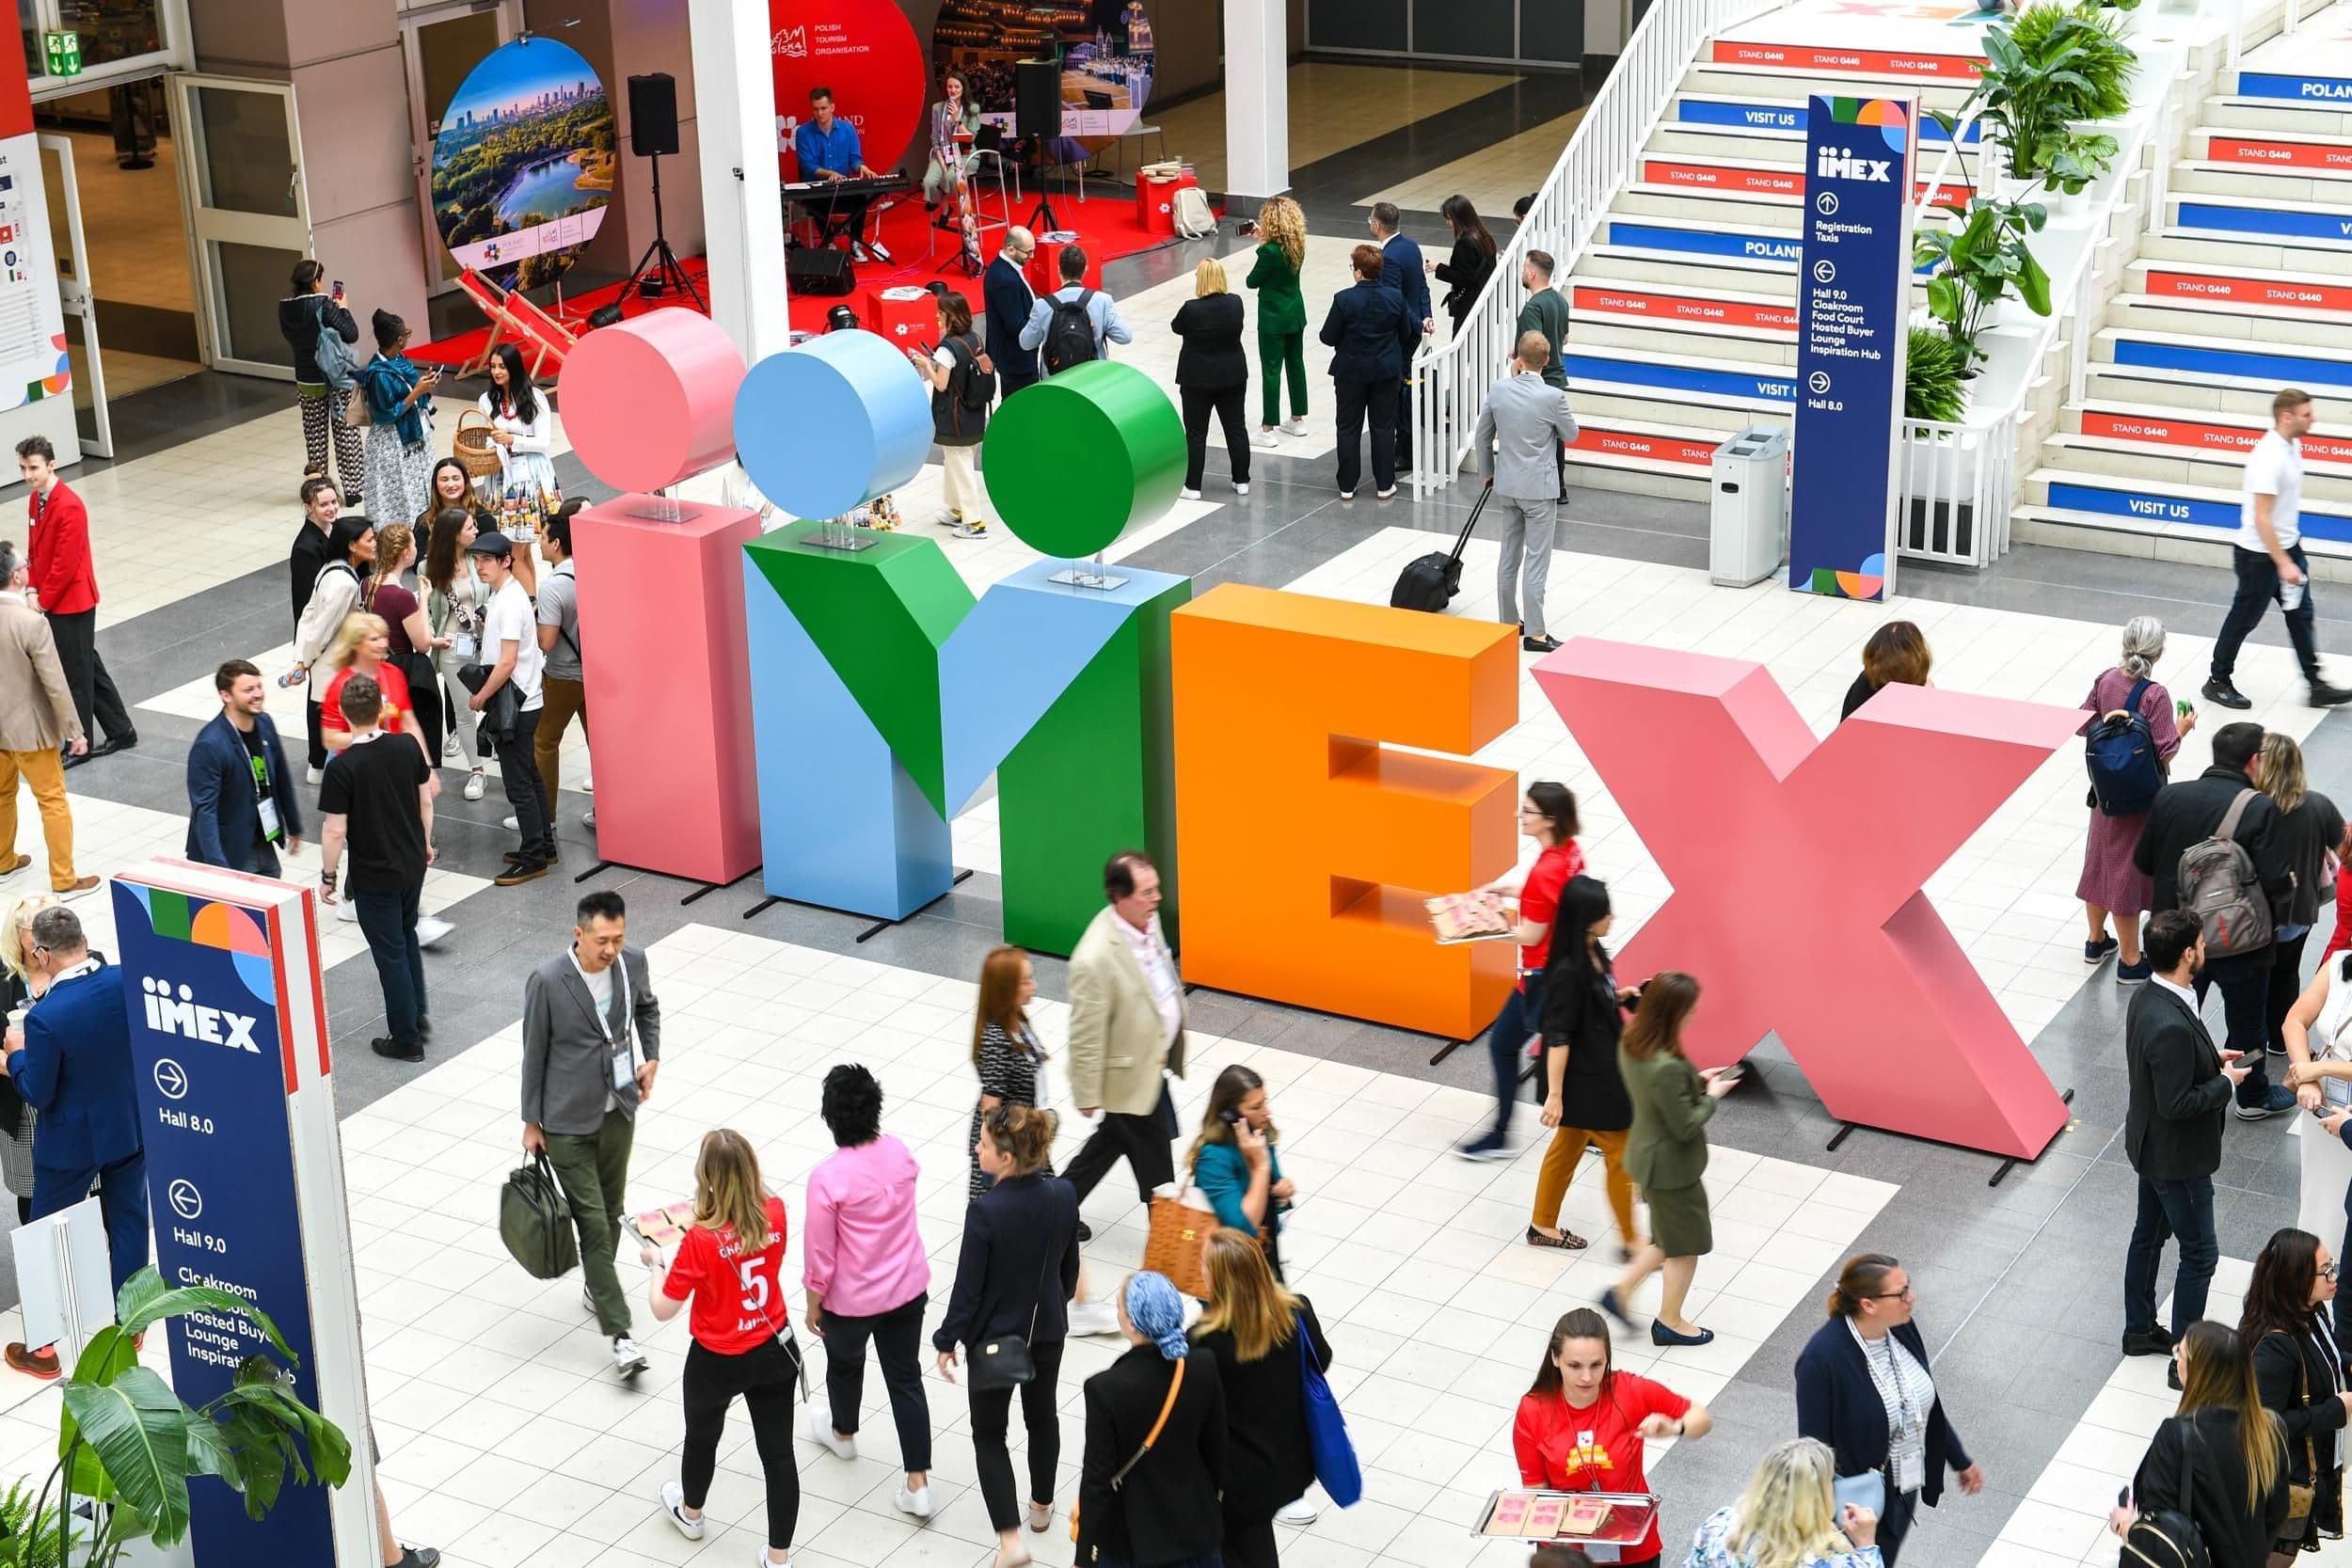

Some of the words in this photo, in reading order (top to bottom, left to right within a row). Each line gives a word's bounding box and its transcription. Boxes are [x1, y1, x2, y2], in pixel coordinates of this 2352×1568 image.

[816, 35, 847, 43] TOURISM
[815, 45, 869, 55] ORGANISATION
[1738, 50, 1763, 59] STAND
[1764, 52, 1784, 61] G440
[1813, 55, 1838, 64] STAND
[1840, 56, 1860, 66] G440
[1889, 59, 1915, 70] STAND
[1916, 61, 1938, 71] G440
[1745, 111, 1775, 124] VISIT
[1779, 114, 1795, 126] US
[2237, 148, 2266, 158] STAND
[2268, 150, 2292, 160] G440
[1670, 171, 1694, 181] STAND
[1696, 173, 1717, 182] G440
[1745, 178, 1772, 187] STAND
[1772, 180, 1793, 189] G440
[1816, 220, 1872, 234] Registration
[1816, 231, 1839, 243] Taxis
[2176, 281, 2206, 293] STAND
[2207, 285, 2231, 294] G440
[1813, 288, 1831, 298] Hall
[1833, 290, 1847, 300] 9.0
[2266, 289, 2296, 300] STAND
[2298, 292, 2322, 302] G440
[1599, 297, 1625, 307] STAND
[1626, 299, 1645, 309] G440
[1812, 299, 1863, 312] Cloakroom
[1677, 305, 1702, 315] STAND
[1704, 308, 1724, 317] G440
[1755, 313, 1781, 323] STAND
[1783, 315, 1800, 325] G44
[1812, 310, 1836, 322] Food
[1836, 313, 1864, 325] Court
[1811, 322, 1845, 334] Hosted
[1847, 325, 1874, 338] Buyer
[1811, 333, 1846, 345] Lounge
[1810, 343, 1859, 357] Inspiration
[1861, 349, 1882, 360] Hub
[1756, 382, 1789, 396] VISIT
[1808, 399, 1826, 409] Hall
[1828, 401, 1843, 411] 8.0
[2112, 423, 2142, 435] STAND
[2144, 427, 2168, 437] G440
[2203, 433, 2234, 445] STAND
[1602, 439, 1629, 449] STAND
[1629, 443, 1650, 452] G440
[2297, 443, 2329, 454] STAND
[1681, 448, 1708, 459] STAND
[2129, 499, 2167, 515] VISIT
[2169, 505, 2190, 518] US
[159, 1107, 188, 1129] Hall
[190, 1115, 214, 1134] 8.0
[173, 1227, 202, 1248] Hall
[204, 1235, 227, 1254] 9.0
[740, 1256, 769, 1311] 5
[184, 1309, 235, 1333] Hosted
[185, 1323, 239, 1352] Lounge
[187, 1342, 244, 1369] Inspirat
